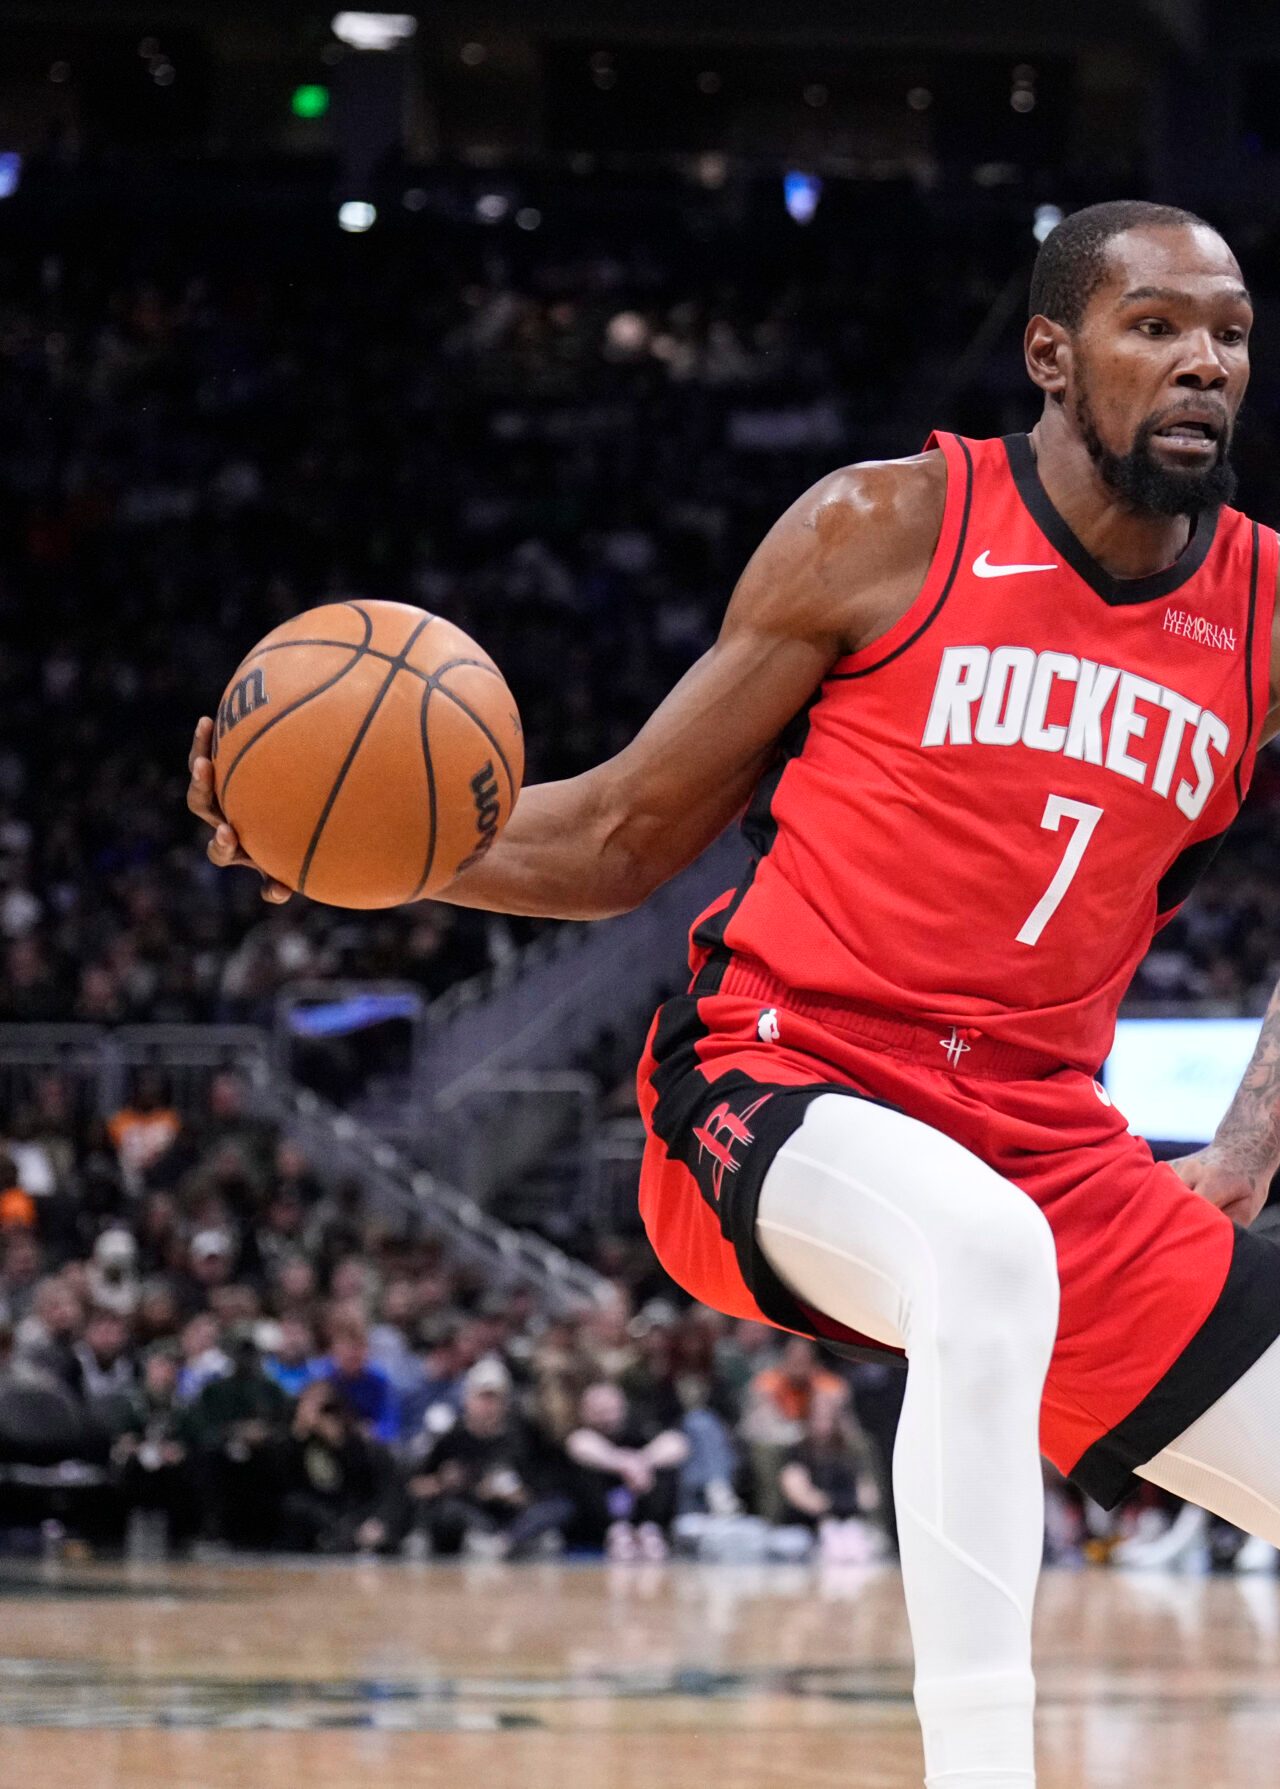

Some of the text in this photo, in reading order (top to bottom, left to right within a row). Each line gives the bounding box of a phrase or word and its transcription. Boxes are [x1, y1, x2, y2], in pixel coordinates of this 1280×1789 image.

[1163, 619, 1236, 651] HERMANN
[1165, 607, 1237, 641] MEMORIAL
[921, 645, 1230, 821] ROCKETS
[1014, 793, 1105, 947] 7
